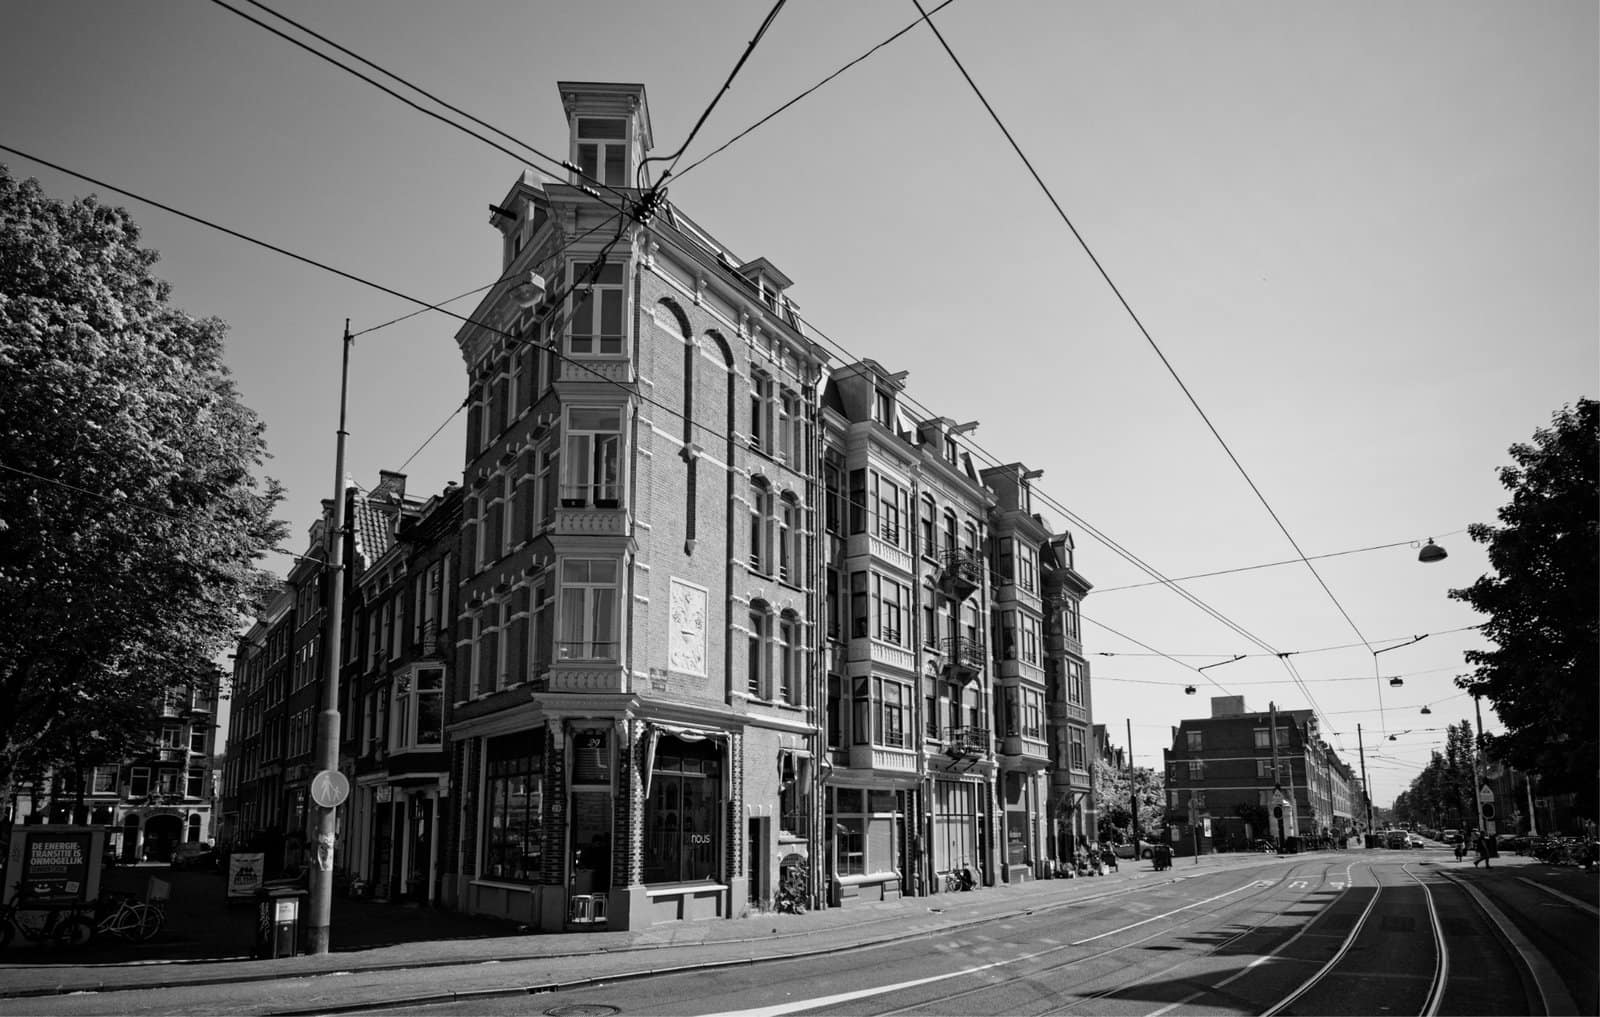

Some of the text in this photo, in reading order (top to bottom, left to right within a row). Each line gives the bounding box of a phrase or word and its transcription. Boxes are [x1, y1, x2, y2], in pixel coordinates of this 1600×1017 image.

[32, 842, 43, 850] DE
[32, 849, 72, 858] TRANSITIE
[30, 857, 83, 865] ONMOGELIJK
